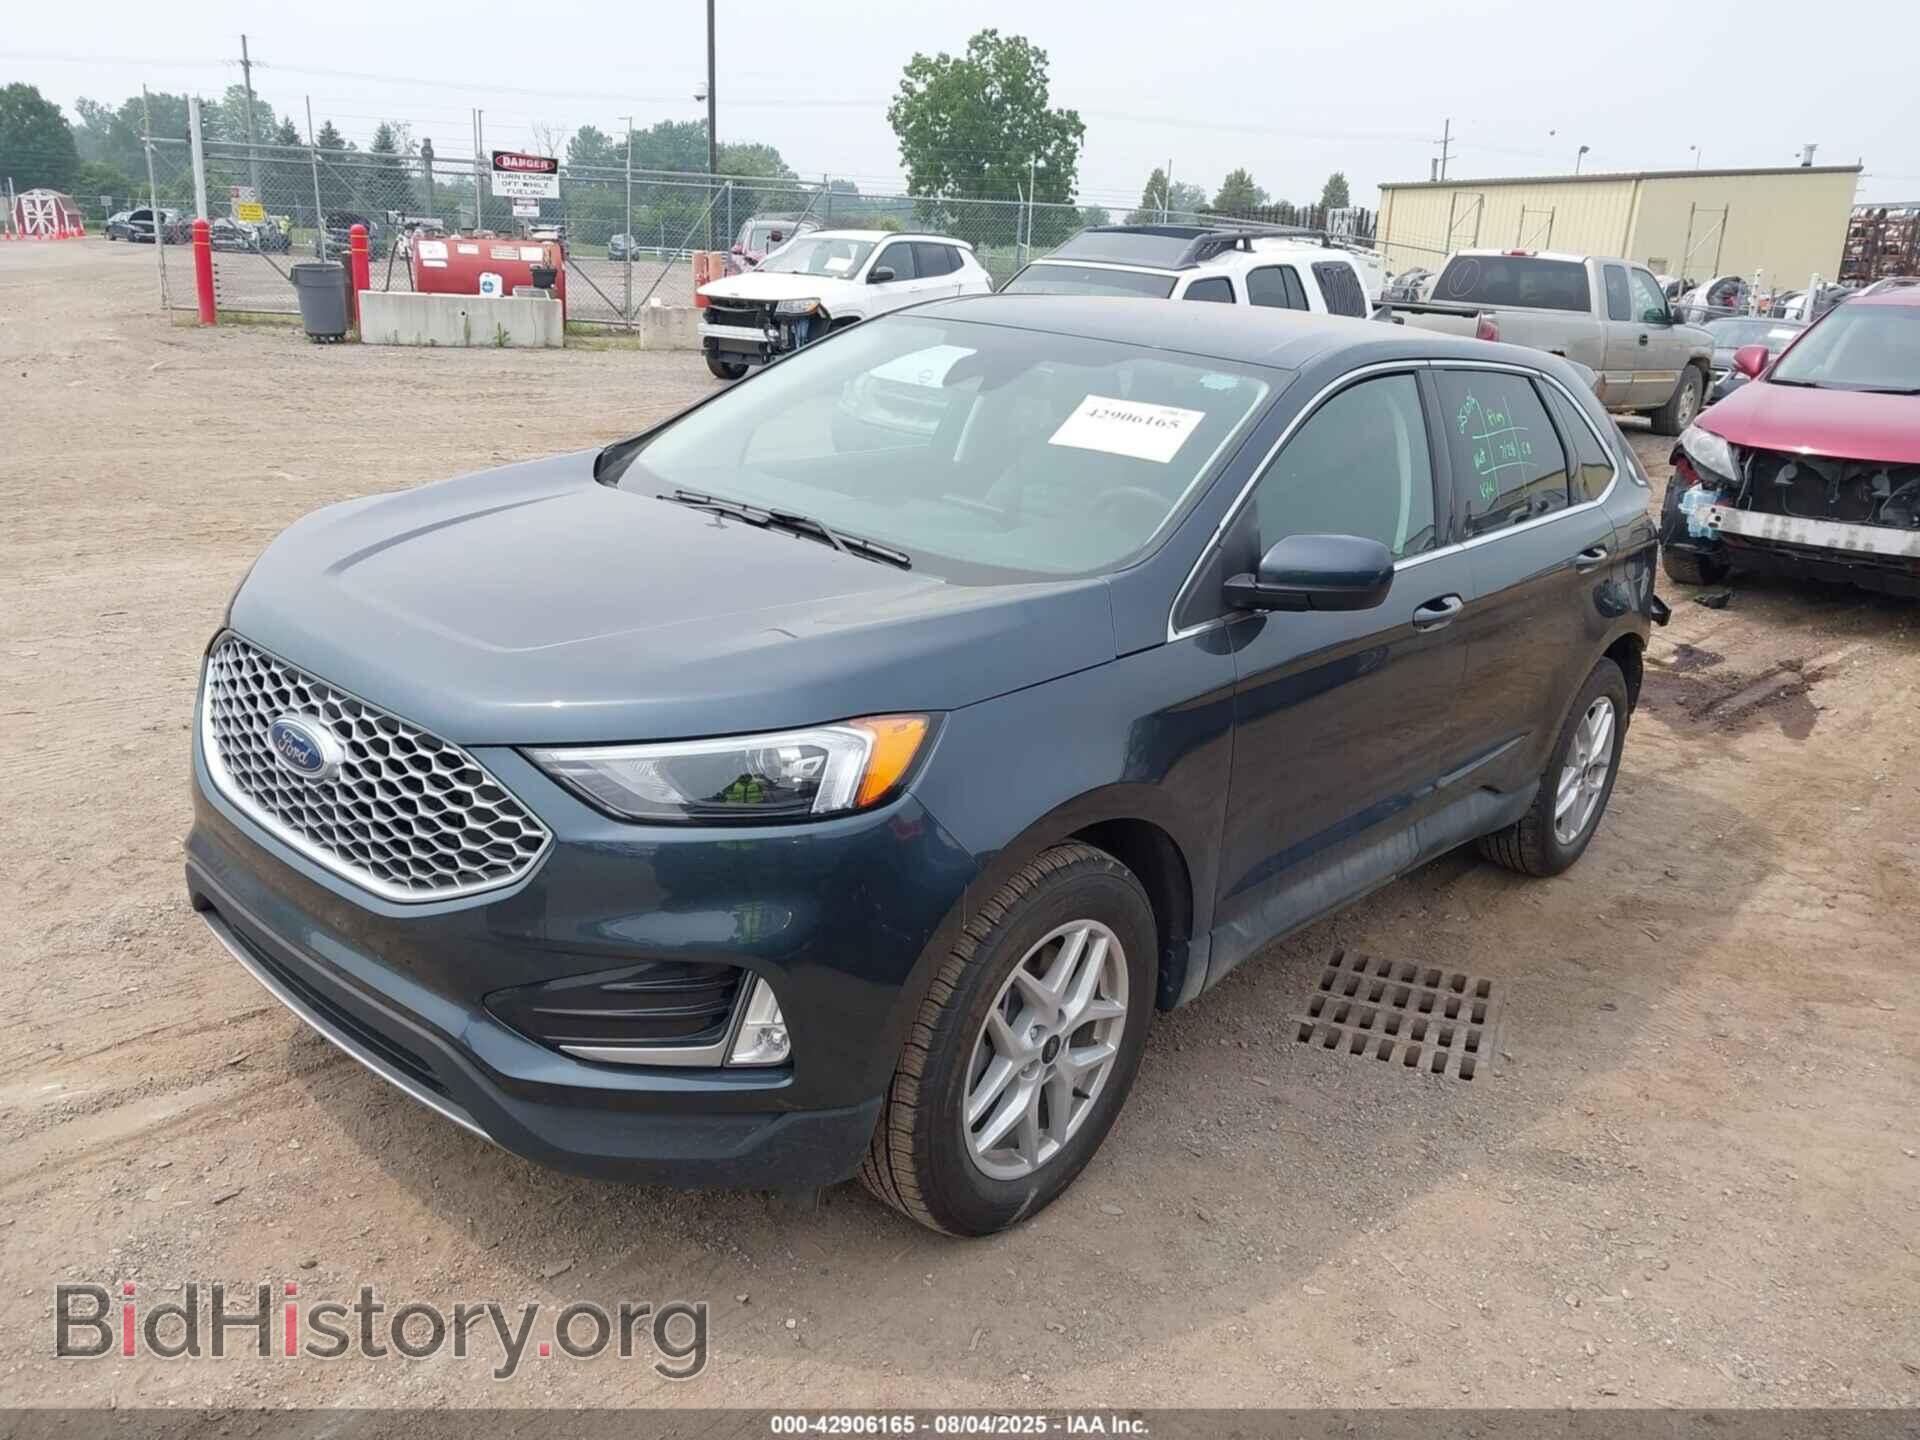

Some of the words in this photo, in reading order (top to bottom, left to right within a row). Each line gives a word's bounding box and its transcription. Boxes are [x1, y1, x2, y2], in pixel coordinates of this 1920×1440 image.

[502, 156, 548, 169] DANGER
[506, 188, 545, 196] FUELING
[1087, 407, 1182, 430] 42906165
[278, 728, 313, 766] Ford
